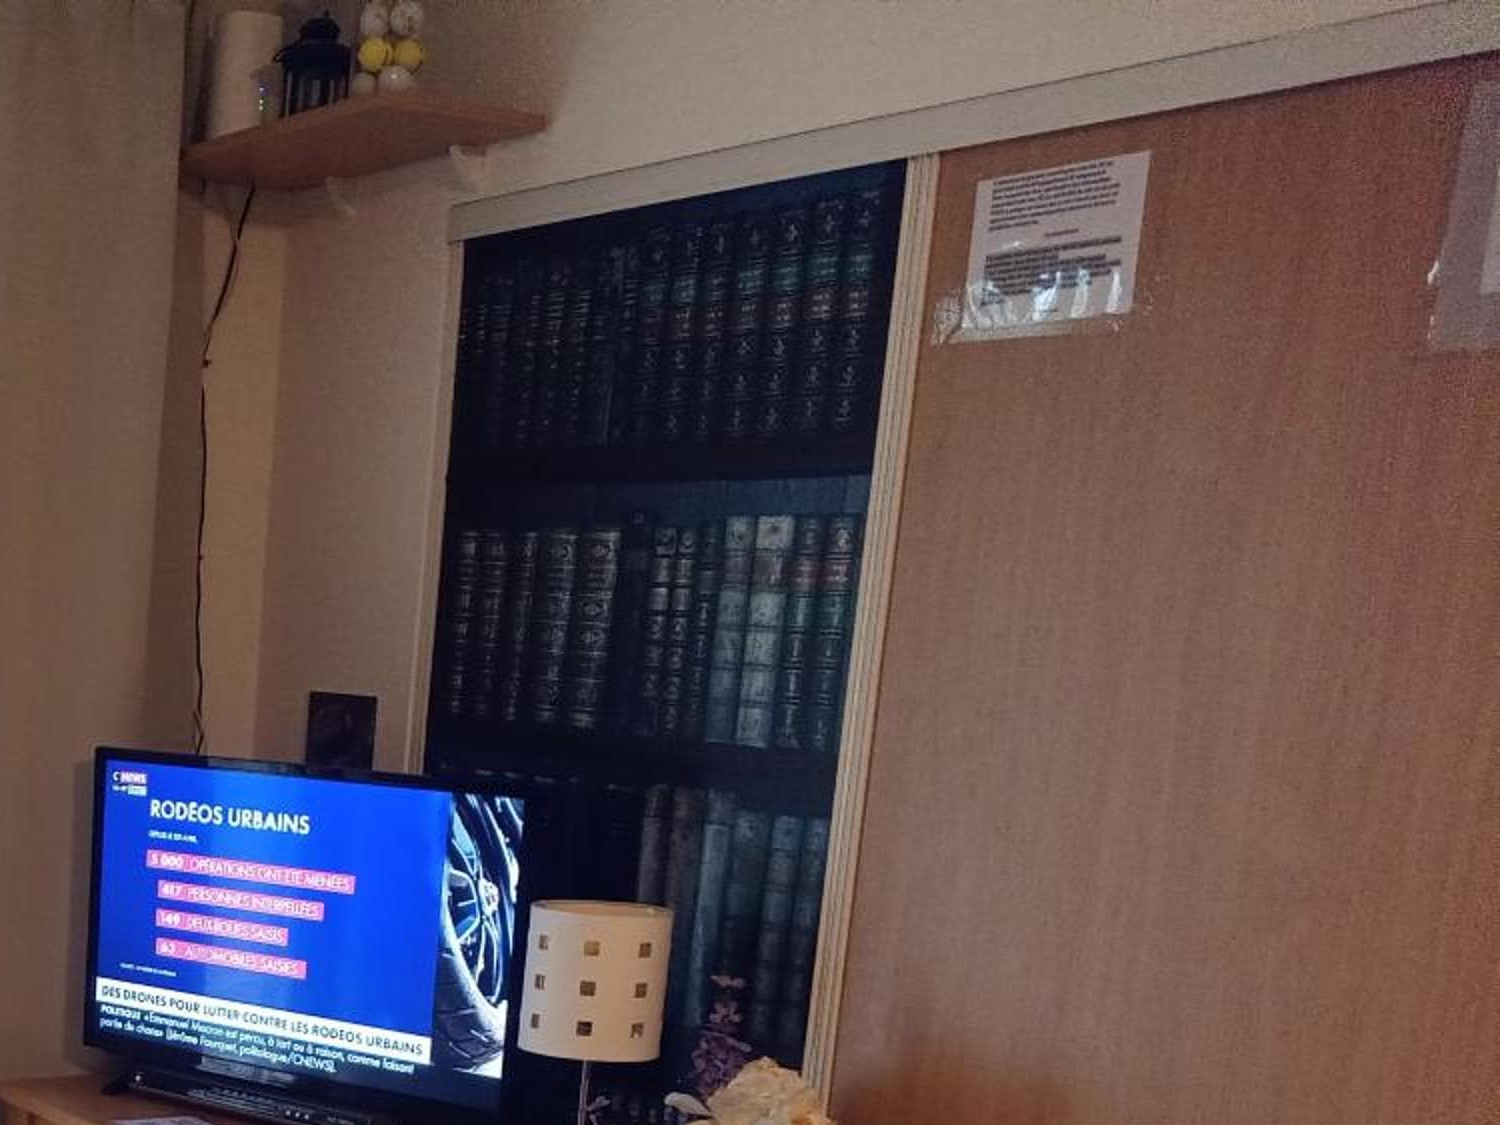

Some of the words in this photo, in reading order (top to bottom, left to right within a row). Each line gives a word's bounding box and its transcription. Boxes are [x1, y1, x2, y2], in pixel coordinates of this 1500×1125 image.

[150, 799, 223, 825] RODÉOS
[227, 808, 311, 835] URBAINS
[102, 985, 121, 999] DES
[123, 989, 167, 1007] DRONES
[169, 997, 200, 1013] POUR
[203, 1004, 240, 1020] LUTTER
[243, 1011, 288, 1029] CONTRE
[291, 1020, 309, 1035] LES
[366, 1035, 424, 1056] URBAINS
[347, 1053, 381, 1068] comme
